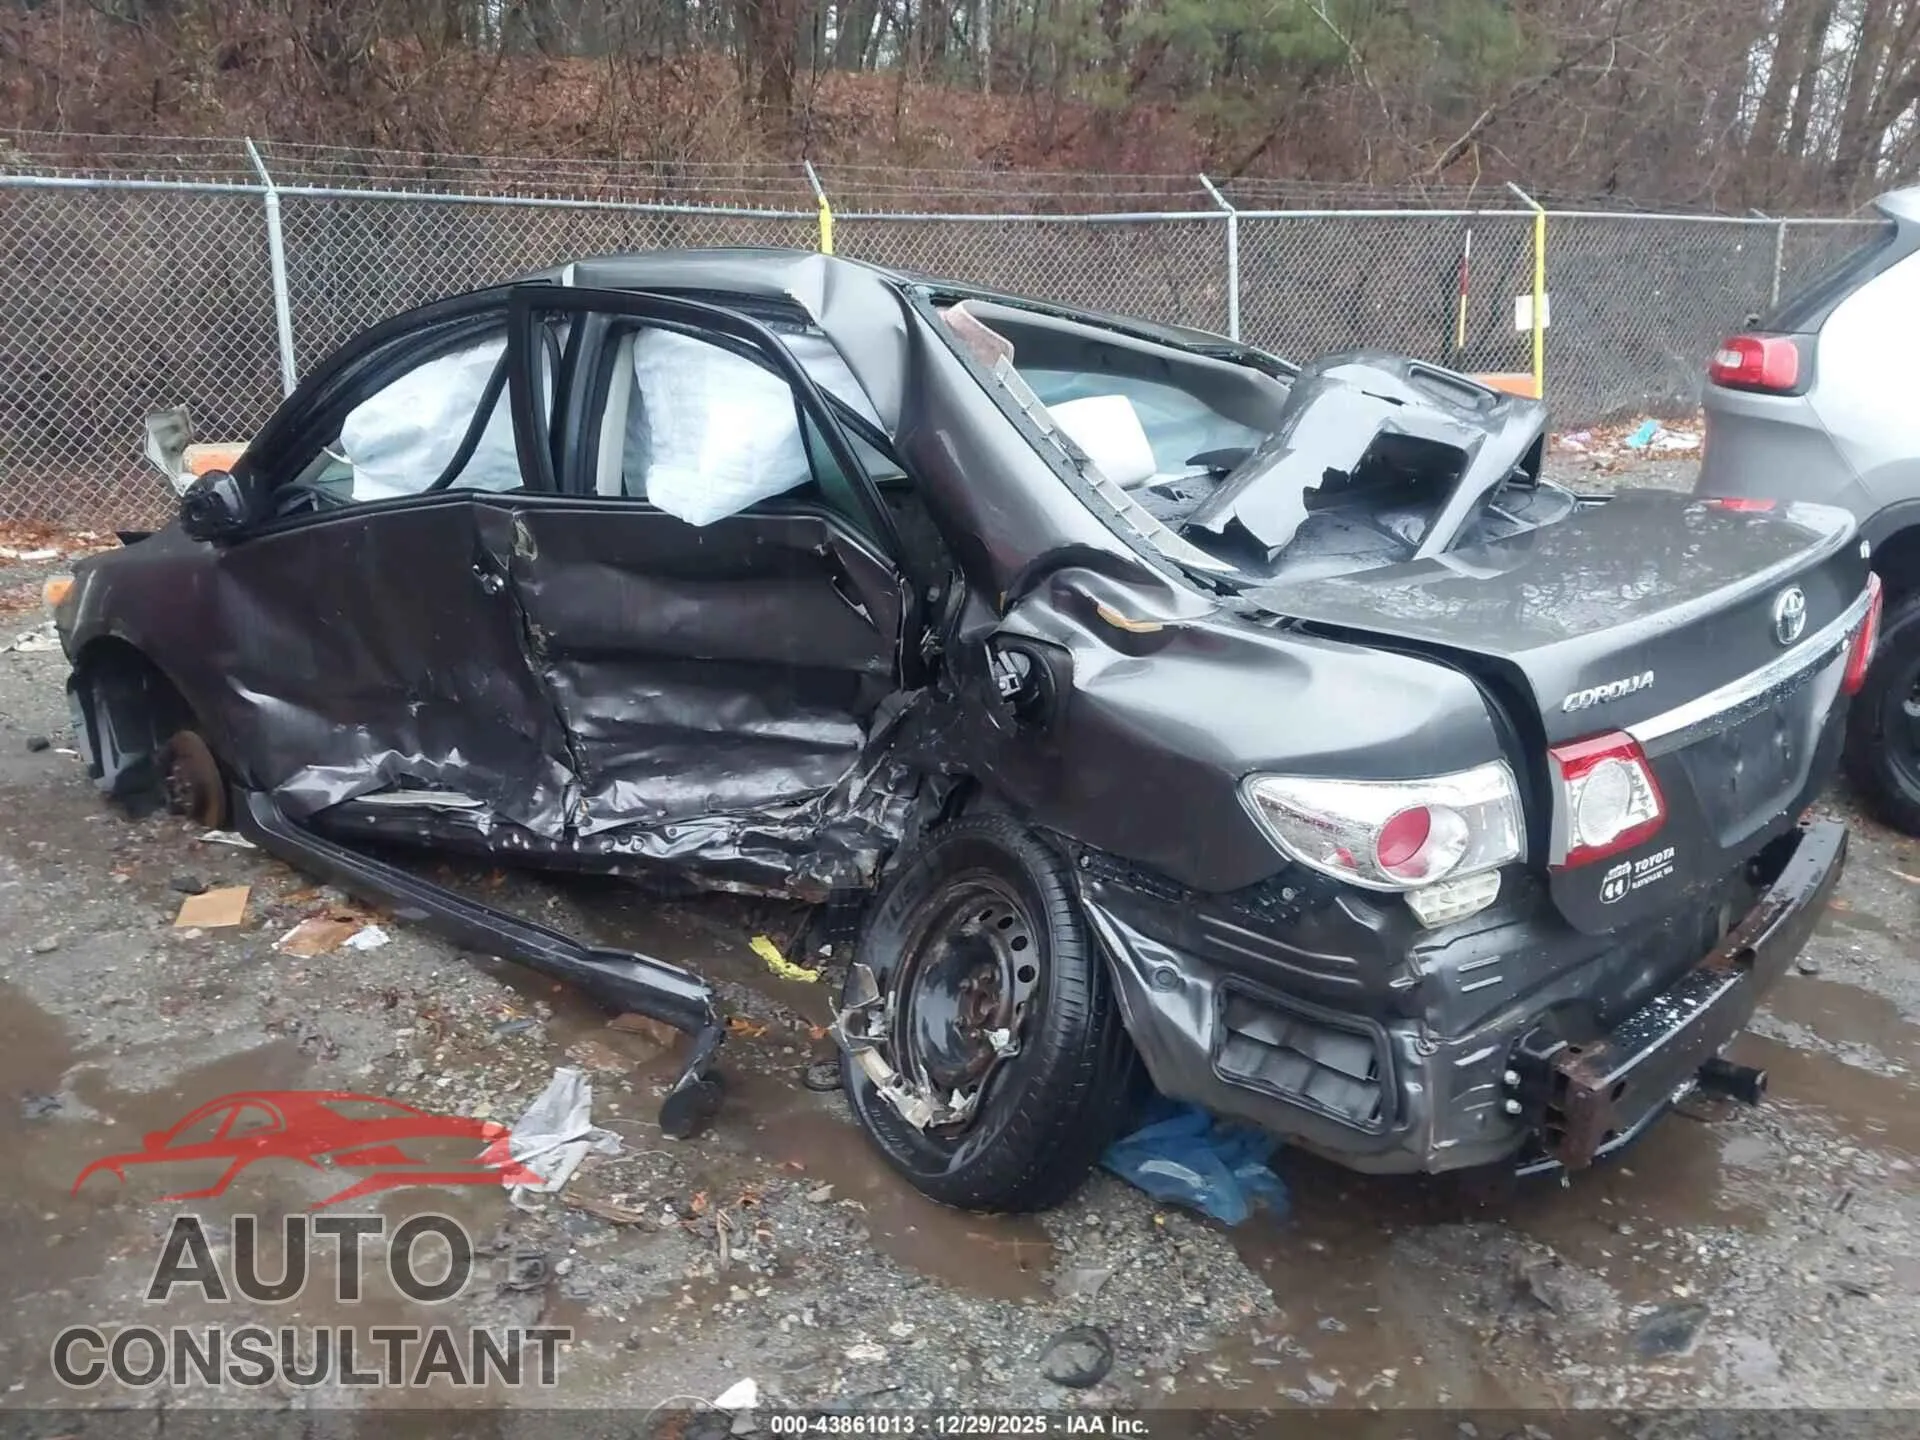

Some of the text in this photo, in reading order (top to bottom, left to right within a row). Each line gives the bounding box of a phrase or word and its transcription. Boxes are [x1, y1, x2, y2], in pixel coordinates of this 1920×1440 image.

[1562, 670, 1654, 712] COROLLA
[1634, 847, 1675, 873] TOYOTA
[1604, 879, 1624, 899] 44
